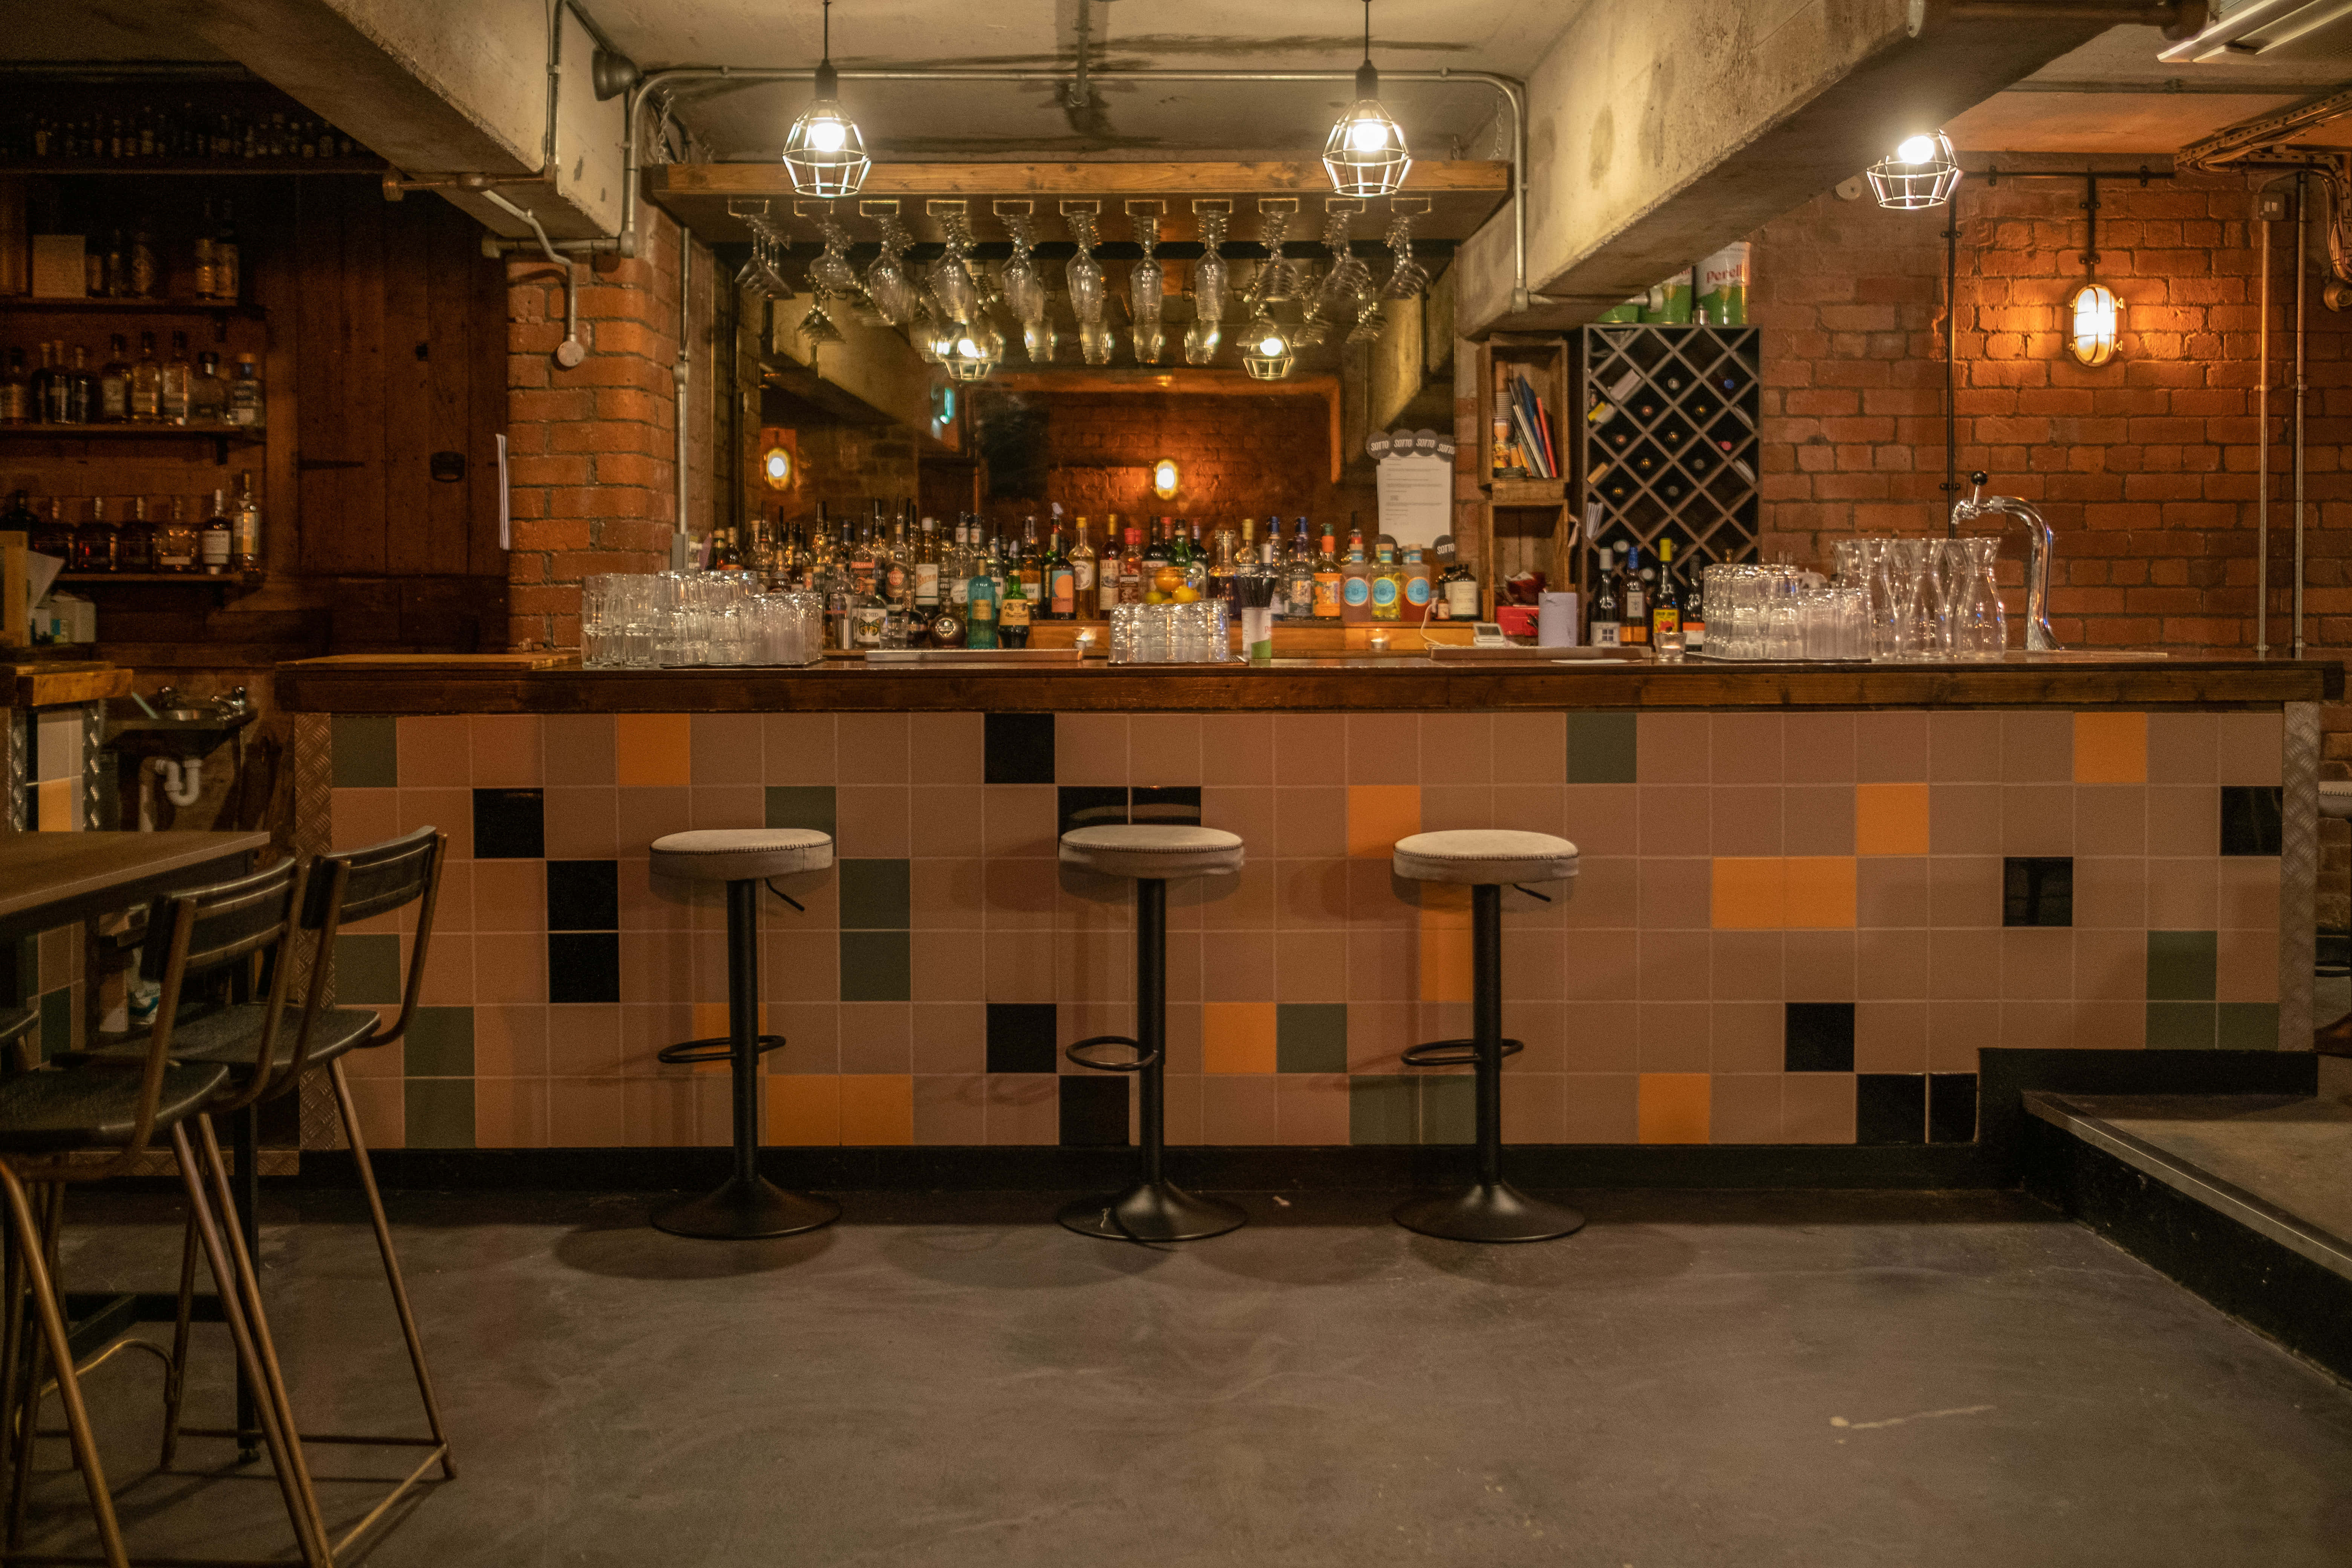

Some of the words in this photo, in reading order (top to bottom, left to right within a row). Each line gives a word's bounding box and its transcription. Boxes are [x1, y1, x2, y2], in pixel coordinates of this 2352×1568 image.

[1707, 264, 1743, 283] Perell
[1370, 441, 1389, 452] SOTTO
[1393, 439, 1412, 447] SOTTO
[1416, 439, 1435, 448] SOTTO
[1437, 443, 1455, 455] SOTTO
[1437, 543, 1455, 554] SOTTO
[1661, 584, 1674, 594] 22
